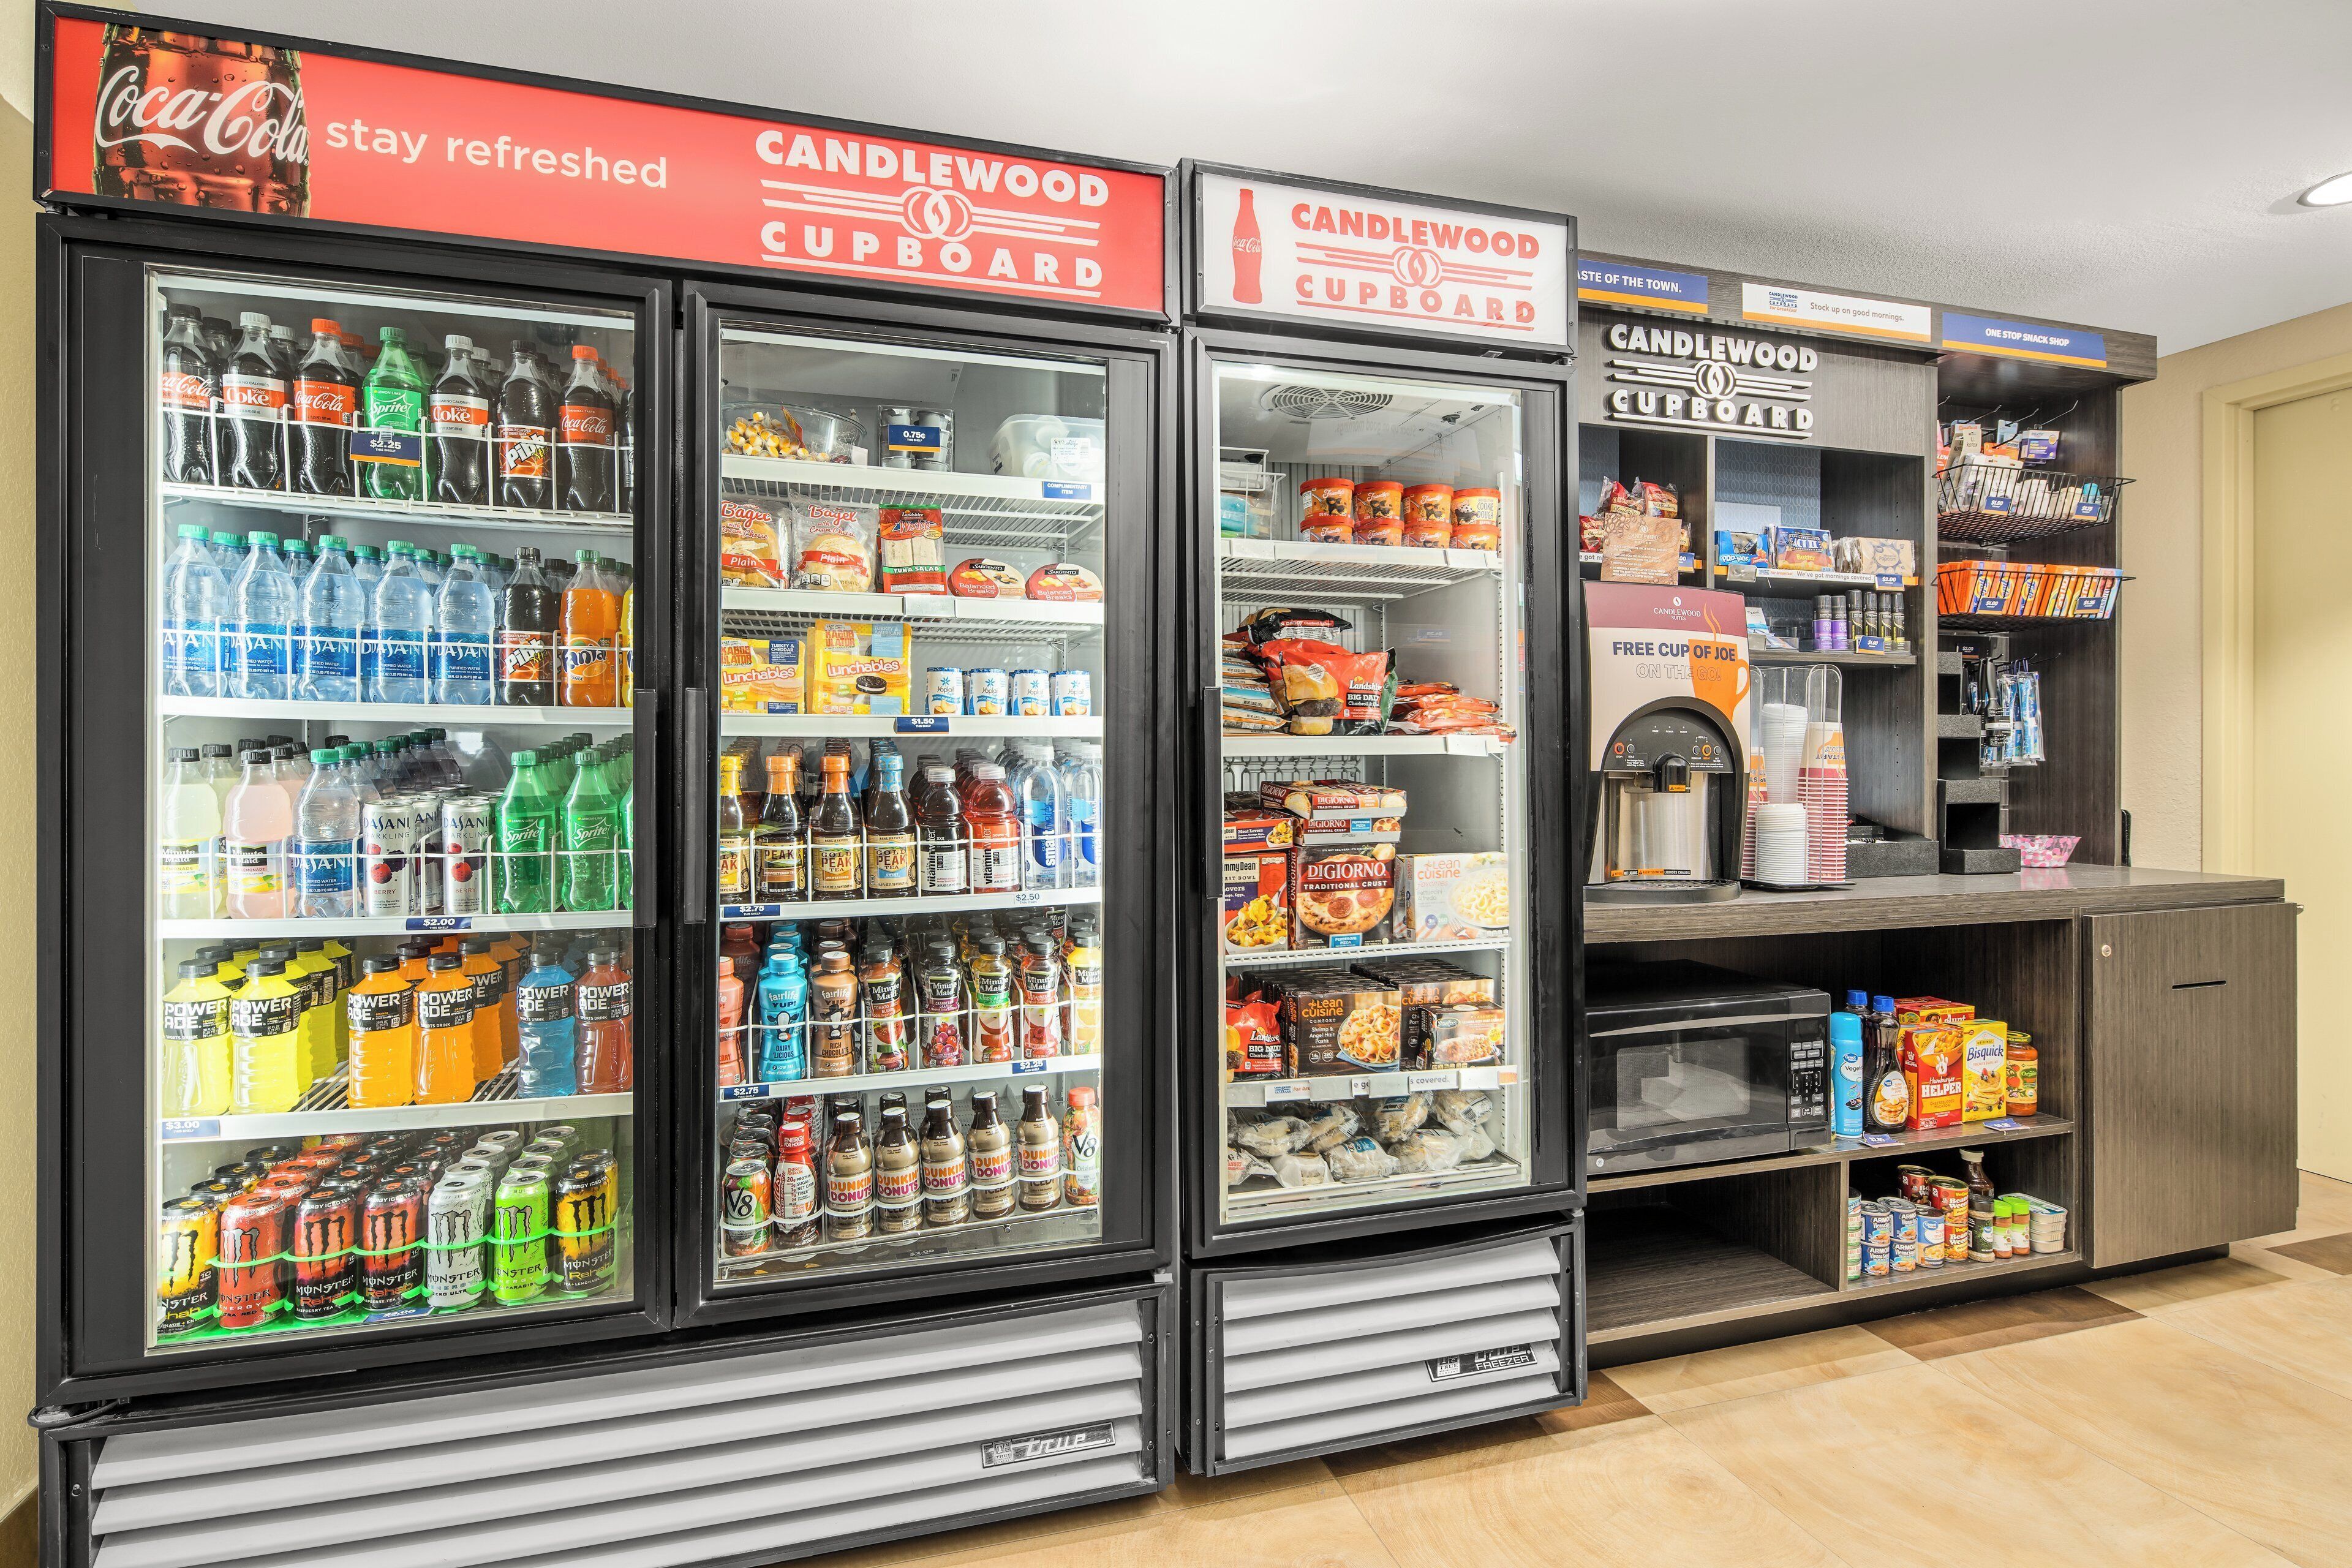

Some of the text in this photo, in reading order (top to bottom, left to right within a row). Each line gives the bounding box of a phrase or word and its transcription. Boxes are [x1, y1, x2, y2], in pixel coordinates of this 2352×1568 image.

[95, 65, 309, 165] Coca-Cola
[325, 118, 668, 189] stay refreshed
[755, 130, 1109, 208] CANDLEWOOD
[1291, 203, 1539, 259] CANDLEWOOD
[1232, 235, 1262, 254] Coca-Cola
[761, 221, 1102, 287] CUPBOARD
[1604, 273, 1619, 284] OF
[1622, 275, 1644, 288] THE
[1646, 279, 1682, 293] TOWN.
[1296, 274, 1535, 323] CUPBOARD
[1811, 302, 1830, 312] Stock
[1872, 312, 1904, 322] mornings.
[1985, 328, 2070, 346] ONE STOP SNACK SHOP
[1610, 323, 1818, 371] CANDLEWOOD
[226, 388, 270, 405] Coke
[295, 393, 347, 412] Coca-Cola
[371, 401, 408, 416] Sprite
[433, 405, 471, 423] Coke
[1612, 389, 1814, 429] CUPBOARD
[561, 415, 608, 434] Coca-Cola
[369, 440, 401, 451] $2.25
[1477, 502, 1494, 511] COOKIE
[1477, 510, 1493, 519] DOUGH
[808, 504, 858, 526] Bagel
[744, 530, 769, 539] Cheese
[832, 527, 856, 537] Cheese
[730, 557, 756, 567] Plain
[820, 553, 845, 563] Plain
[1654, 607, 1701, 618] CANDLEWOOD
[1613, 641, 1736, 662] FREE CUP OF JOE
[723, 666, 795, 685] Lunchables
[827, 659, 900, 676] Lunchables
[1636, 663, 1722, 682] ON THE GO!
[505, 827, 540, 843] Sprite
[575, 825, 609, 840] Sprite
[764, 850, 794, 861] PEAK
[821, 857, 851, 867] PEAK
[878, 856, 906, 865] PEAK
[1240, 862, 1256, 870] Dean
[1432, 858, 1460, 870] Lean
[1417, 868, 1460, 878] cuisine
[1016, 893, 1040, 902] $2.50
[419, 989, 473, 1006] POWER
[518, 985, 569, 1000] POWER
[578, 982, 630, 999] POWER
[872, 984, 900, 995] Minute
[165, 999, 227, 1016] POWER
[232, 997, 292, 1014] POWER
[348, 993, 400, 1009] POWER
[1317, 998, 1343, 1008] Lean
[1302, 1006, 1344, 1017] cuisine
[1944, 1014, 1966, 1023] Aunt
[1967, 1044, 2004, 1061] Bisquick
[1416, 1076, 1449, 1084] covered.
[1929, 1076, 1956, 1085] Hamburger
[733, 1087, 759, 1096] $2.75
[1921, 1083, 1962, 1098] HELPER
[165, 1120, 200, 1130] $3.00
[1072, 1131, 1097, 1158] V8
[924, 1161, 965, 1178] DUNKIN'
[1023, 1155, 1059, 1170] DONUTS
[877, 1167, 919, 1186] DUNKIN'
[925, 1173, 965, 1189] DONUTS
[831, 1186, 872, 1203] DONUTS
[878, 1179, 919, 1197] DONUTS
[728, 1187, 753, 1217] V8
[575, 1277, 600, 1286] LEMONADE
[1476, 1355, 1529, 1370] FREEZER
[1027, 1433, 1085, 1457] true
